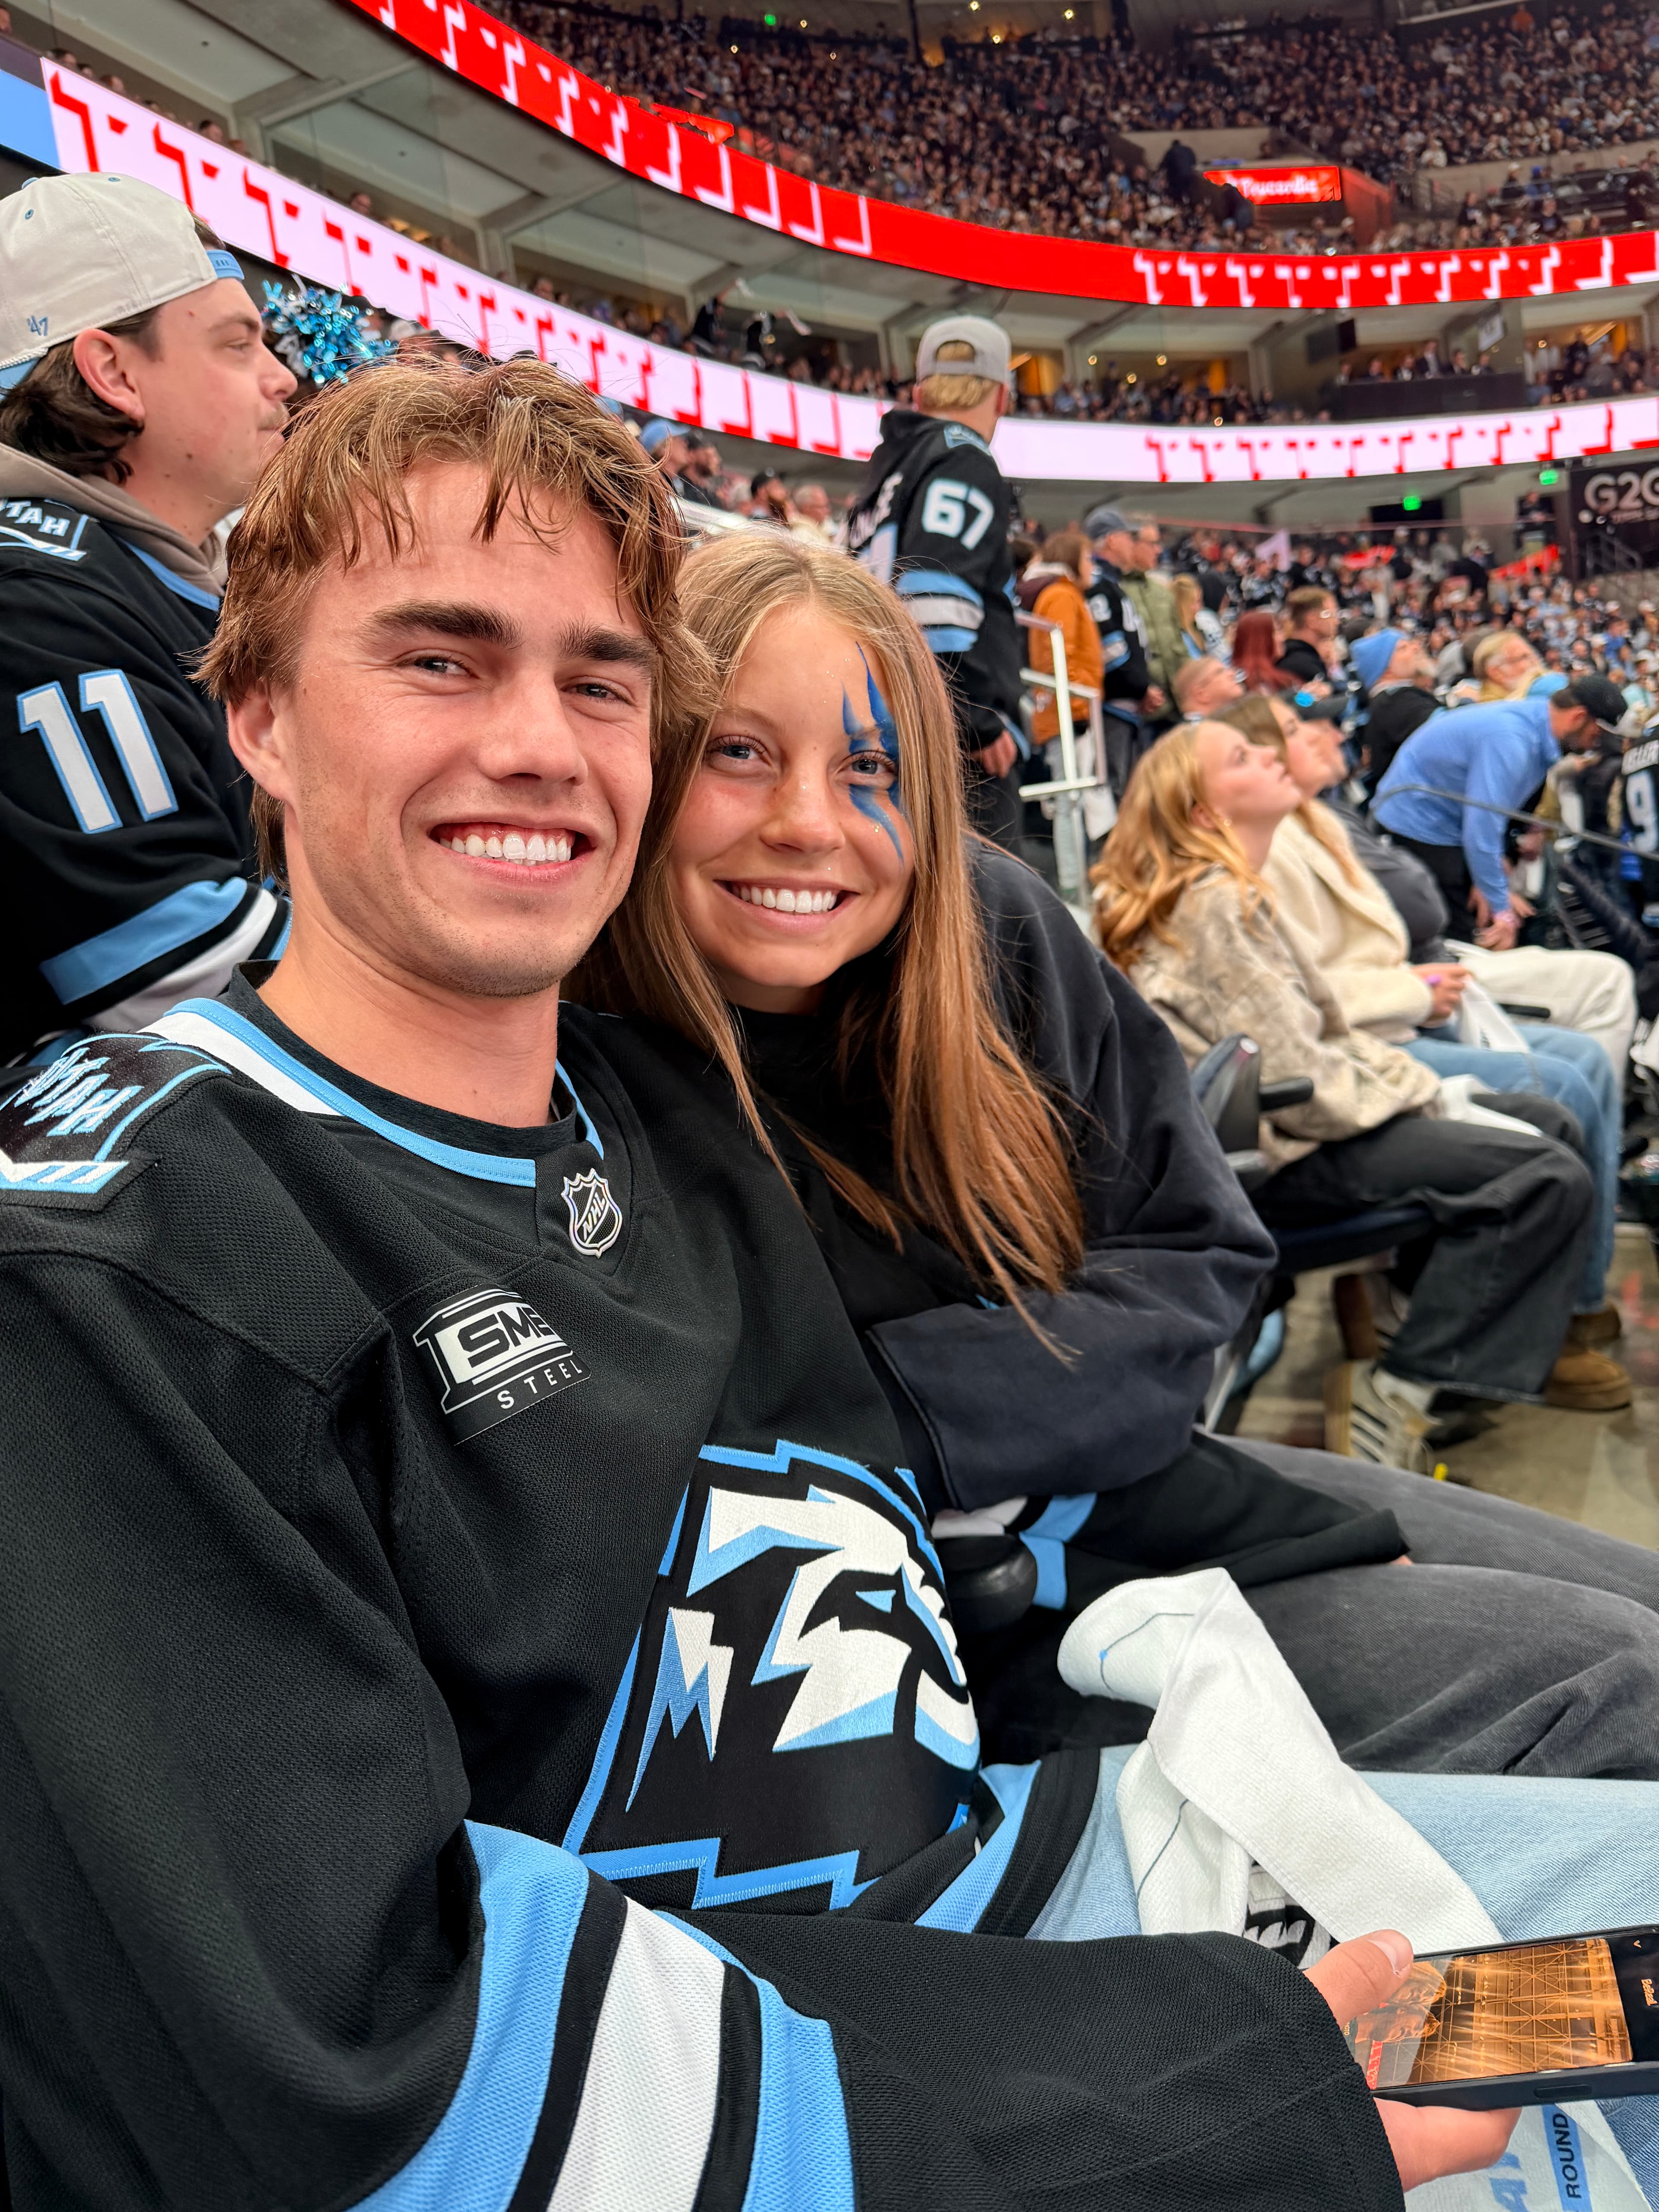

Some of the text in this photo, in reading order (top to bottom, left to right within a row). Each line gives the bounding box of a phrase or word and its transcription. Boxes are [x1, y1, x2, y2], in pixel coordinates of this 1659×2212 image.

[922, 478, 995, 551] 67
[16, 669, 179, 834] 11
[1626, 770, 1658, 852] 9
[14, 1047, 145, 1137] UTAH
[582, 1192, 606, 1241] NHL
[457, 1306, 556, 1369] SME
[497, 1359, 583, 1410] STEEL
[1552, 2113, 1582, 2199] ROUND
